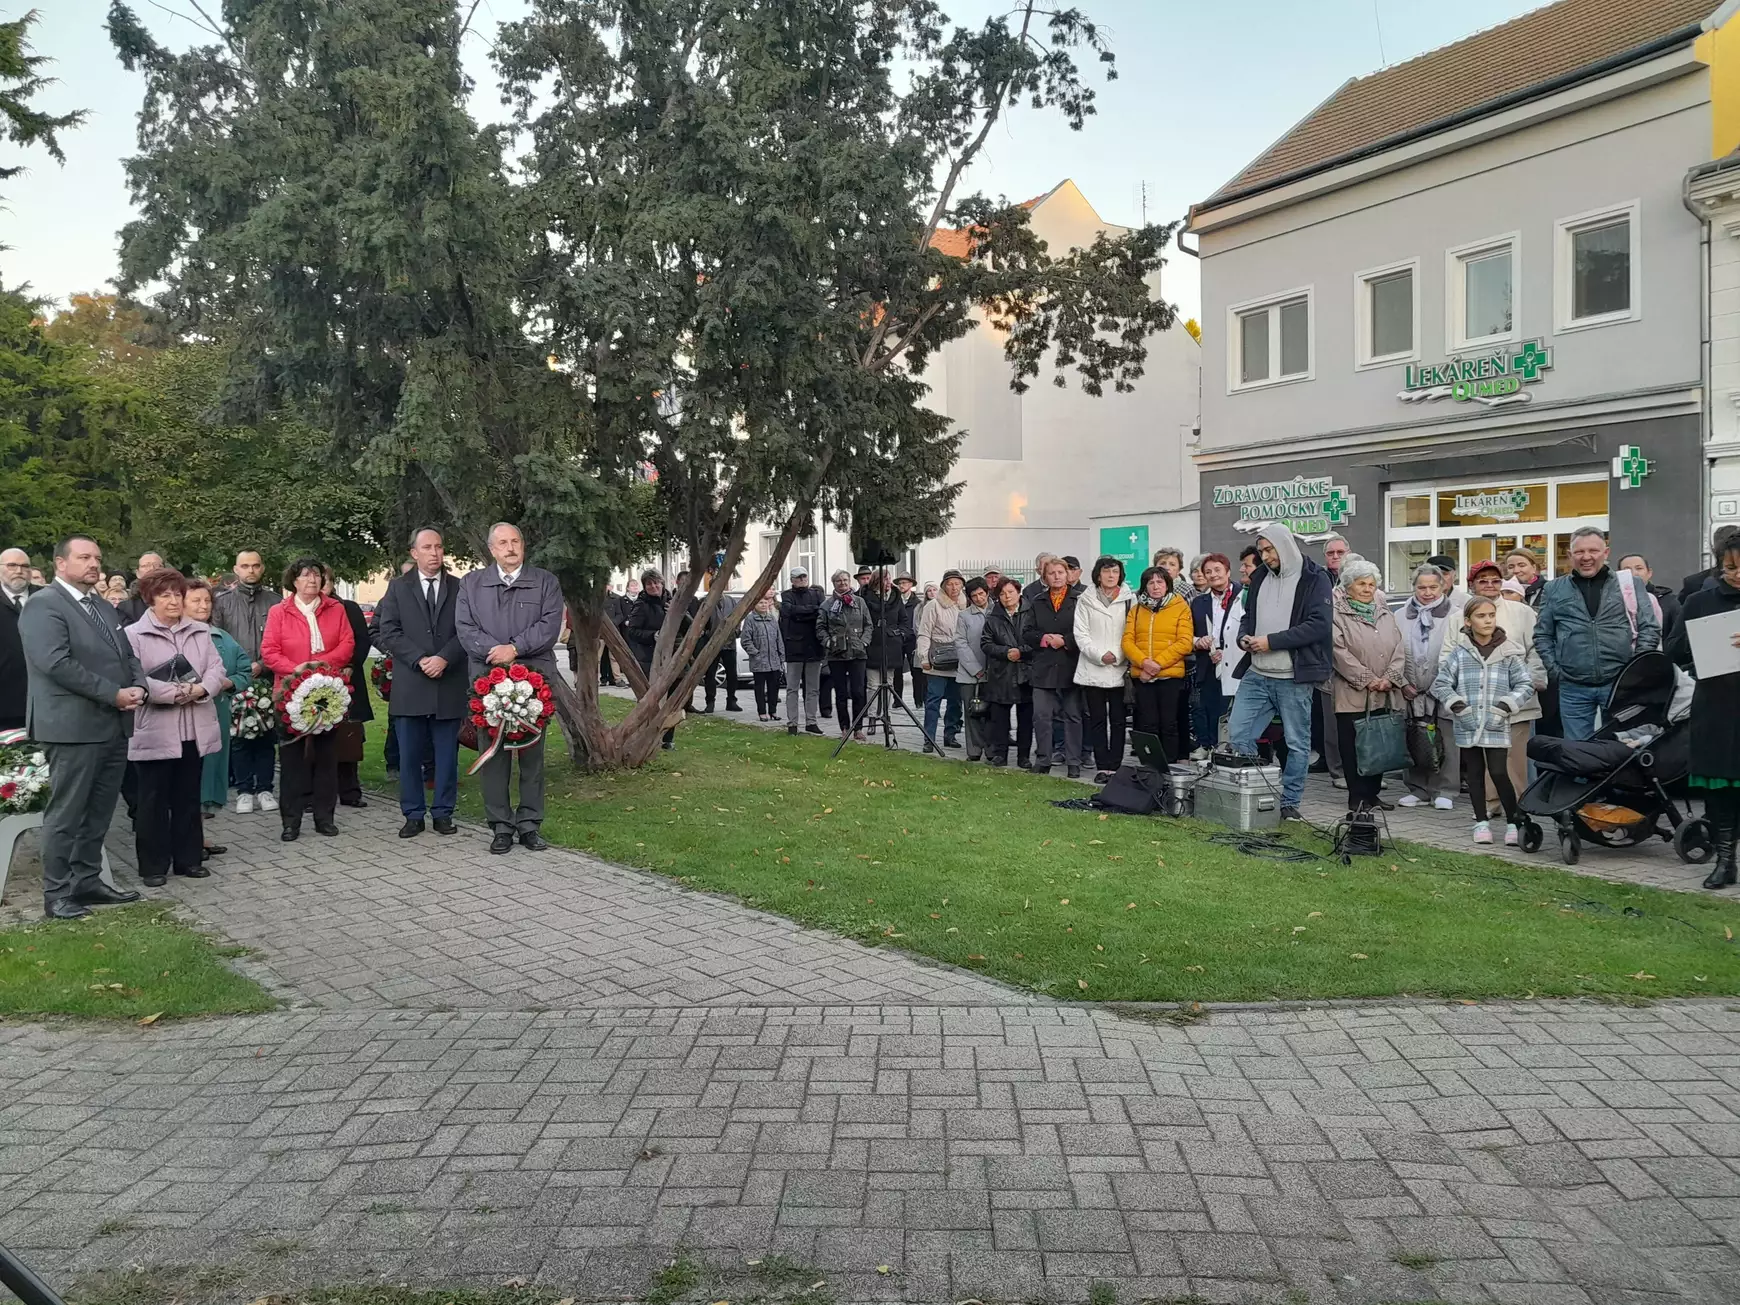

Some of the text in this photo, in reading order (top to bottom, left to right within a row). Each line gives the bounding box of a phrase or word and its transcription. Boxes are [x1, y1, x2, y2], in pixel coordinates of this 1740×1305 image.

[1405, 350, 1507, 388] LEKÁREŇ
[1451, 377, 1519, 401] OLMED
[1214, 478, 1326, 504] ZDRAVOTNÍCKE
[1457, 492, 1508, 508] LEKÁREŇ
[1241, 499, 1318, 519] POMÔCKY
